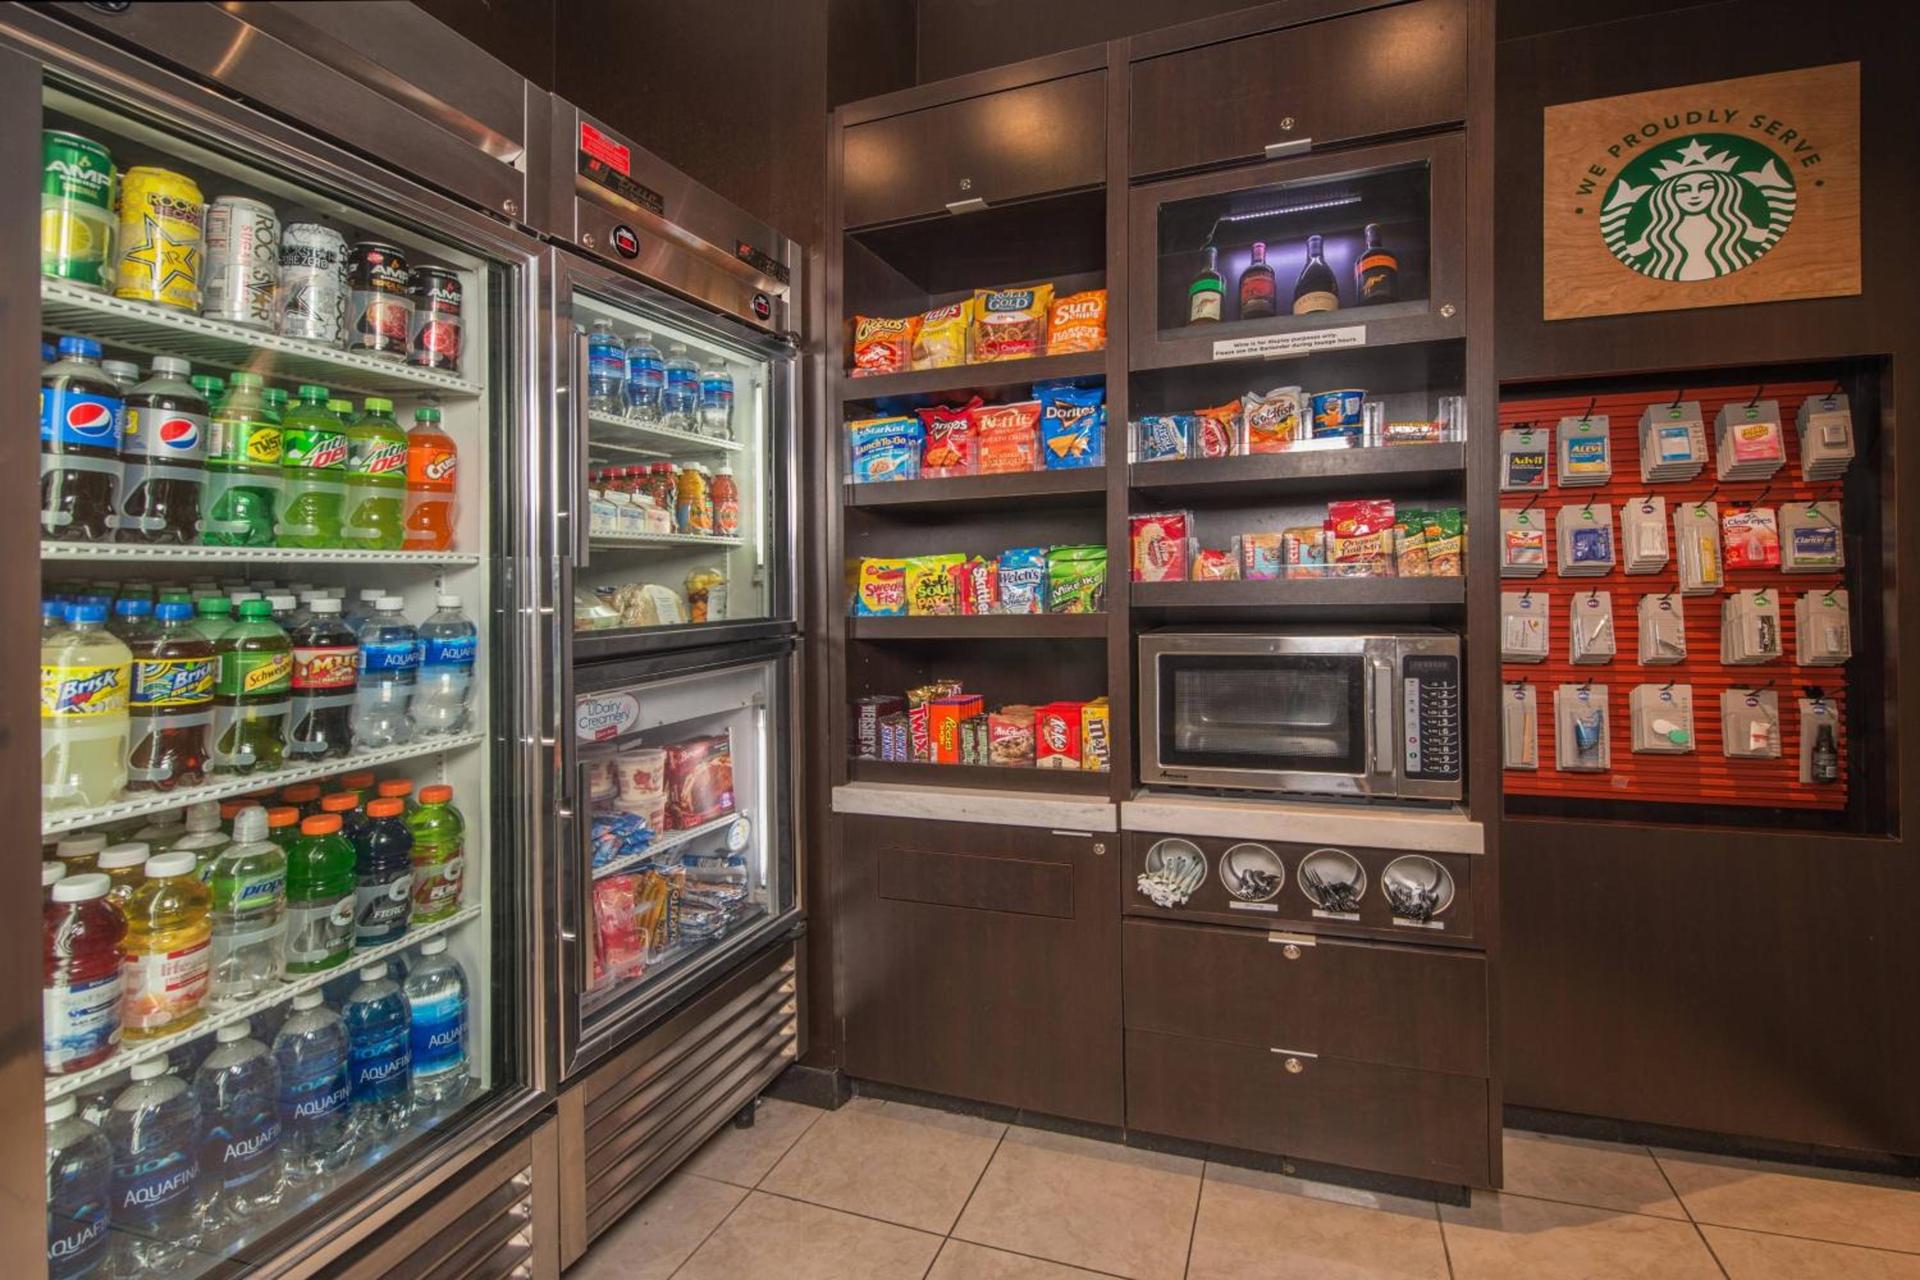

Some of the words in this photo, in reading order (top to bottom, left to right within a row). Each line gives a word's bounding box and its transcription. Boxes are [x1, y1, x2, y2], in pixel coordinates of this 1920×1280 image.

[1576, 163, 1607, 197] WE
[1607, 109, 1739, 158] PROUDLY
[1748, 114, 1821, 168] SERVE
[45, 160, 111, 187] AMP
[988, 297, 1029, 311] GOLD
[1046, 405, 1096, 419] Doritos
[1251, 400, 1295, 426] Goldfish
[855, 438, 884, 456] Lunch
[1512, 455, 1543, 465] Advil
[579, 709, 631, 729] Creamery
[909, 702, 929, 757] TWIX
